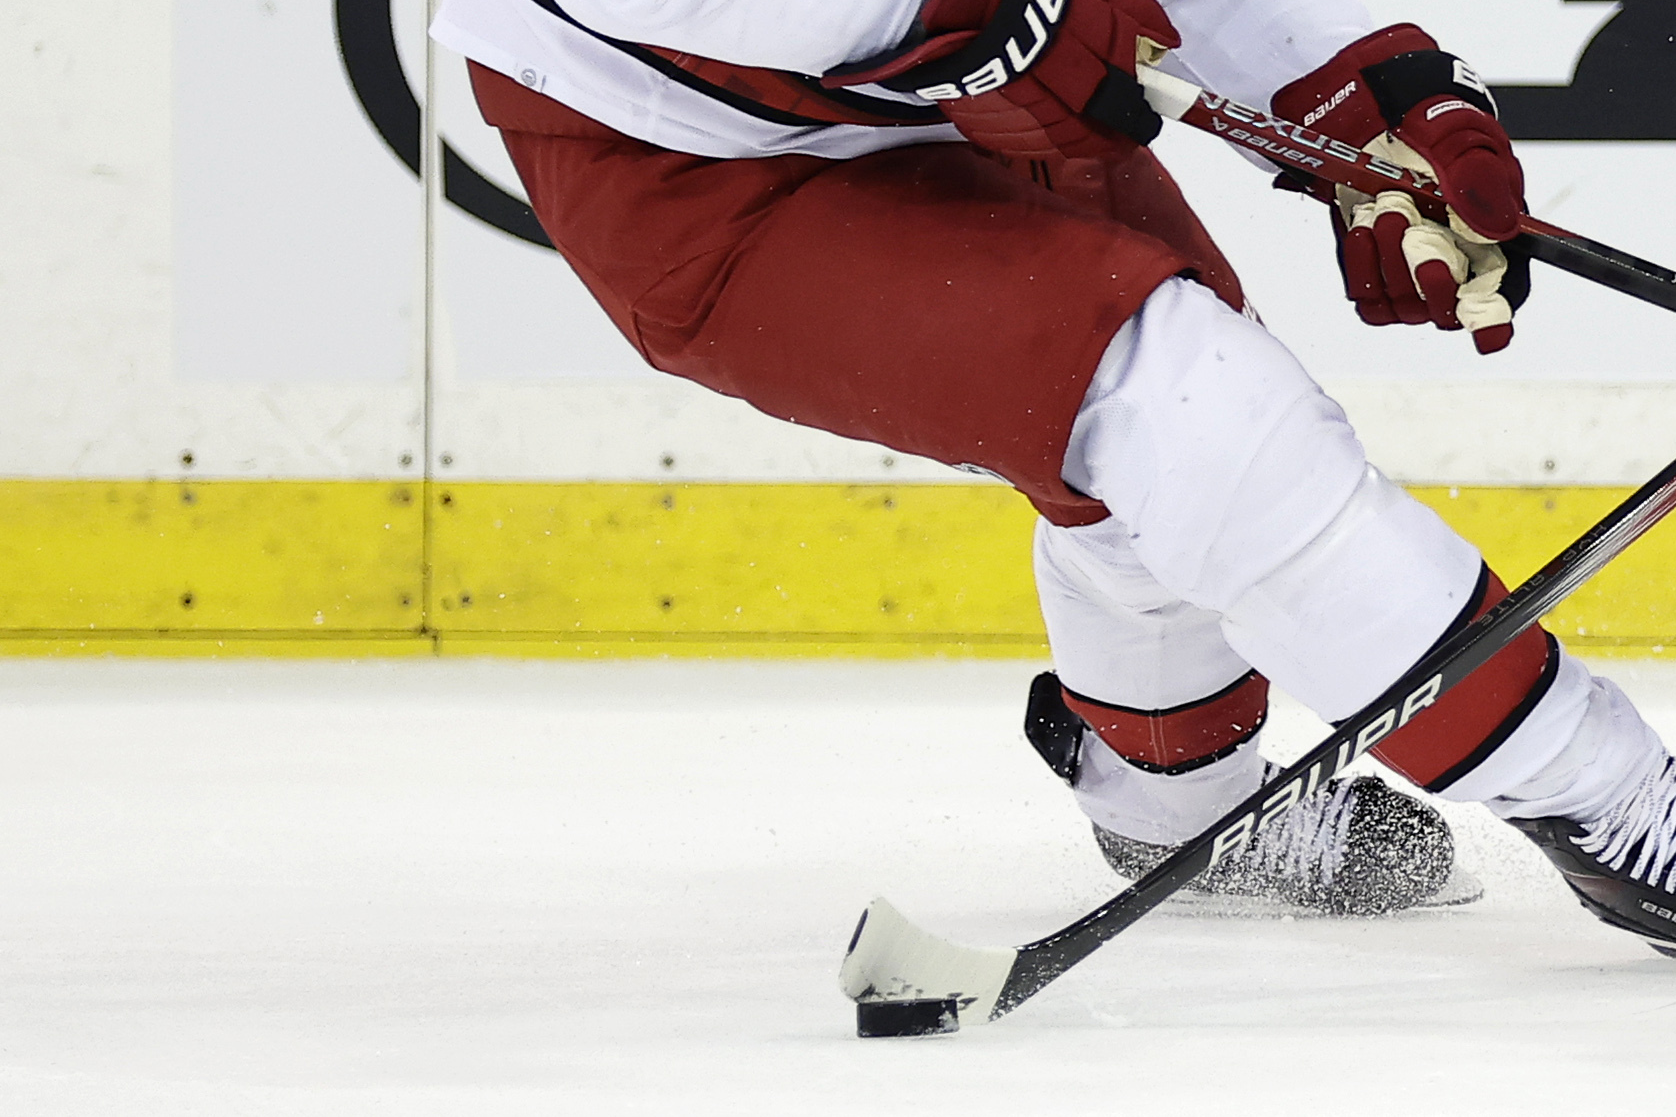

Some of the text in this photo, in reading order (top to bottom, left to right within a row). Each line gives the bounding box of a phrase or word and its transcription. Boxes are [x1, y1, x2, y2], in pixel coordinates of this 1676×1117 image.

[1199, 89, 1362, 164] NEXUS
[1303, 81, 1357, 128] BAUER
[1227, 128, 1325, 169] BAUER
